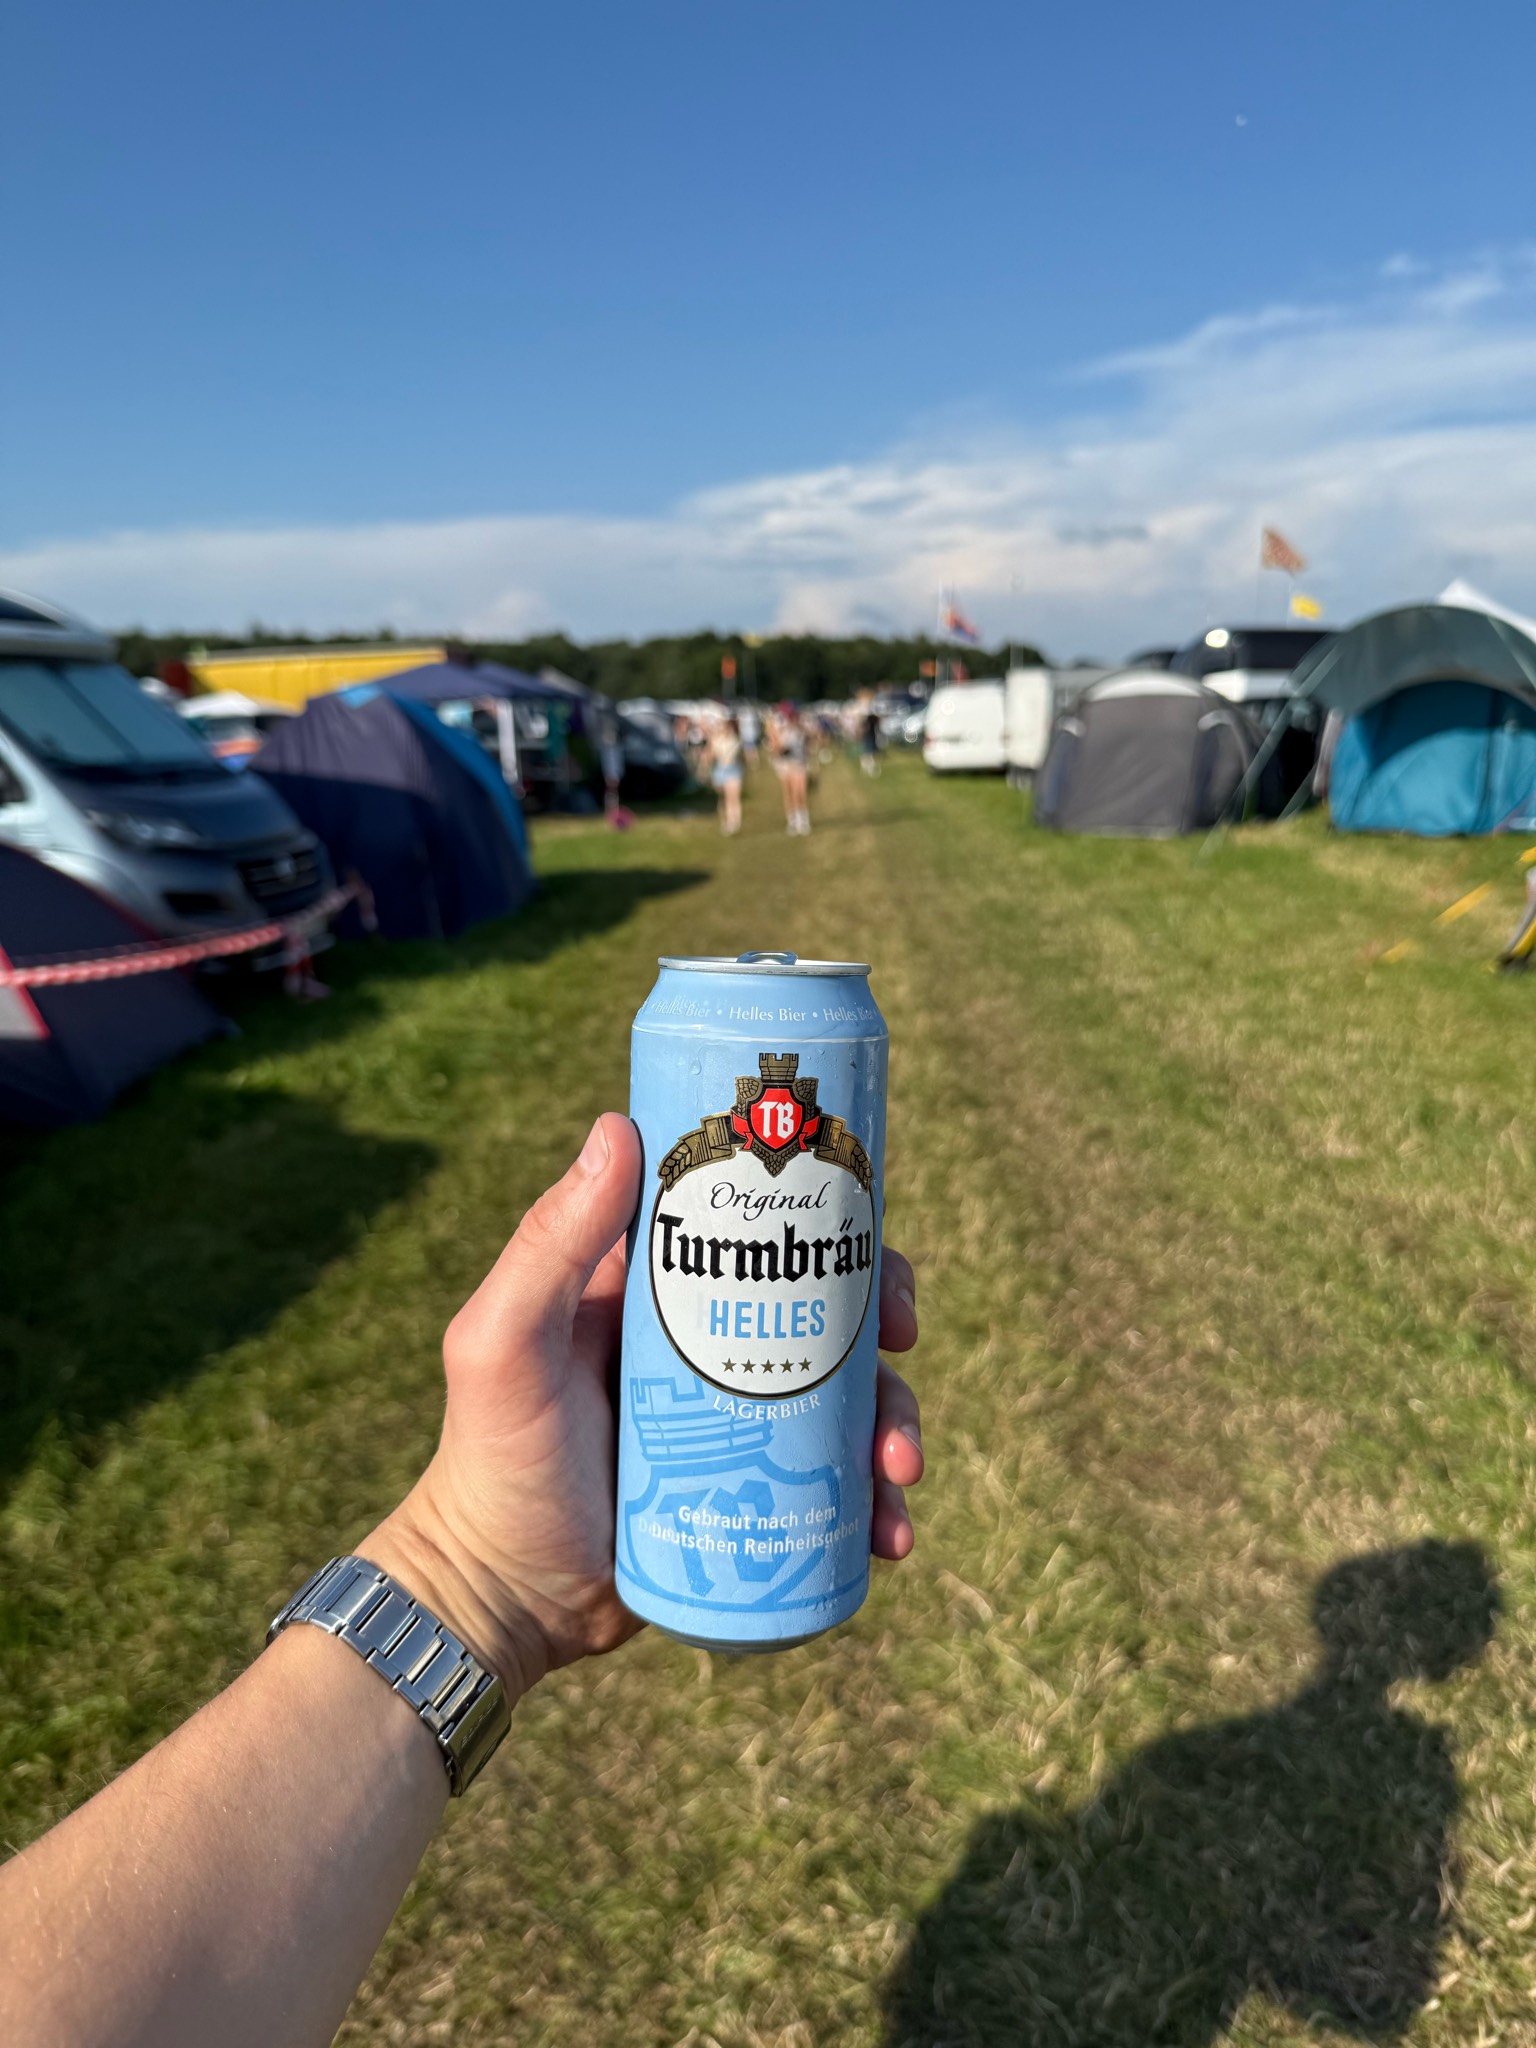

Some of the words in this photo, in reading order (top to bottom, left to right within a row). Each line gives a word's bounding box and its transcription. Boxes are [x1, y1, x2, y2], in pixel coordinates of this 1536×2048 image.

[655, 1000, 684, 1017] Helles
[686, 1002, 712, 1018] Bier
[729, 1006, 774, 1021] Helles
[779, 1008, 806, 1022] Bier
[823, 1007, 858, 1022] Helles
[758, 1101, 795, 1138] TB
[710, 1181, 831, 1221] Original
[656, 1212, 872, 1283] Turmbräu
[709, 1299, 826, 1339] HELLES
[712, 1393, 821, 1421] LAGERBIER
[678, 1505, 752, 1531] Gebraut
[757, 1510, 799, 1531] nach
[805, 1506, 837, 1525] dem
